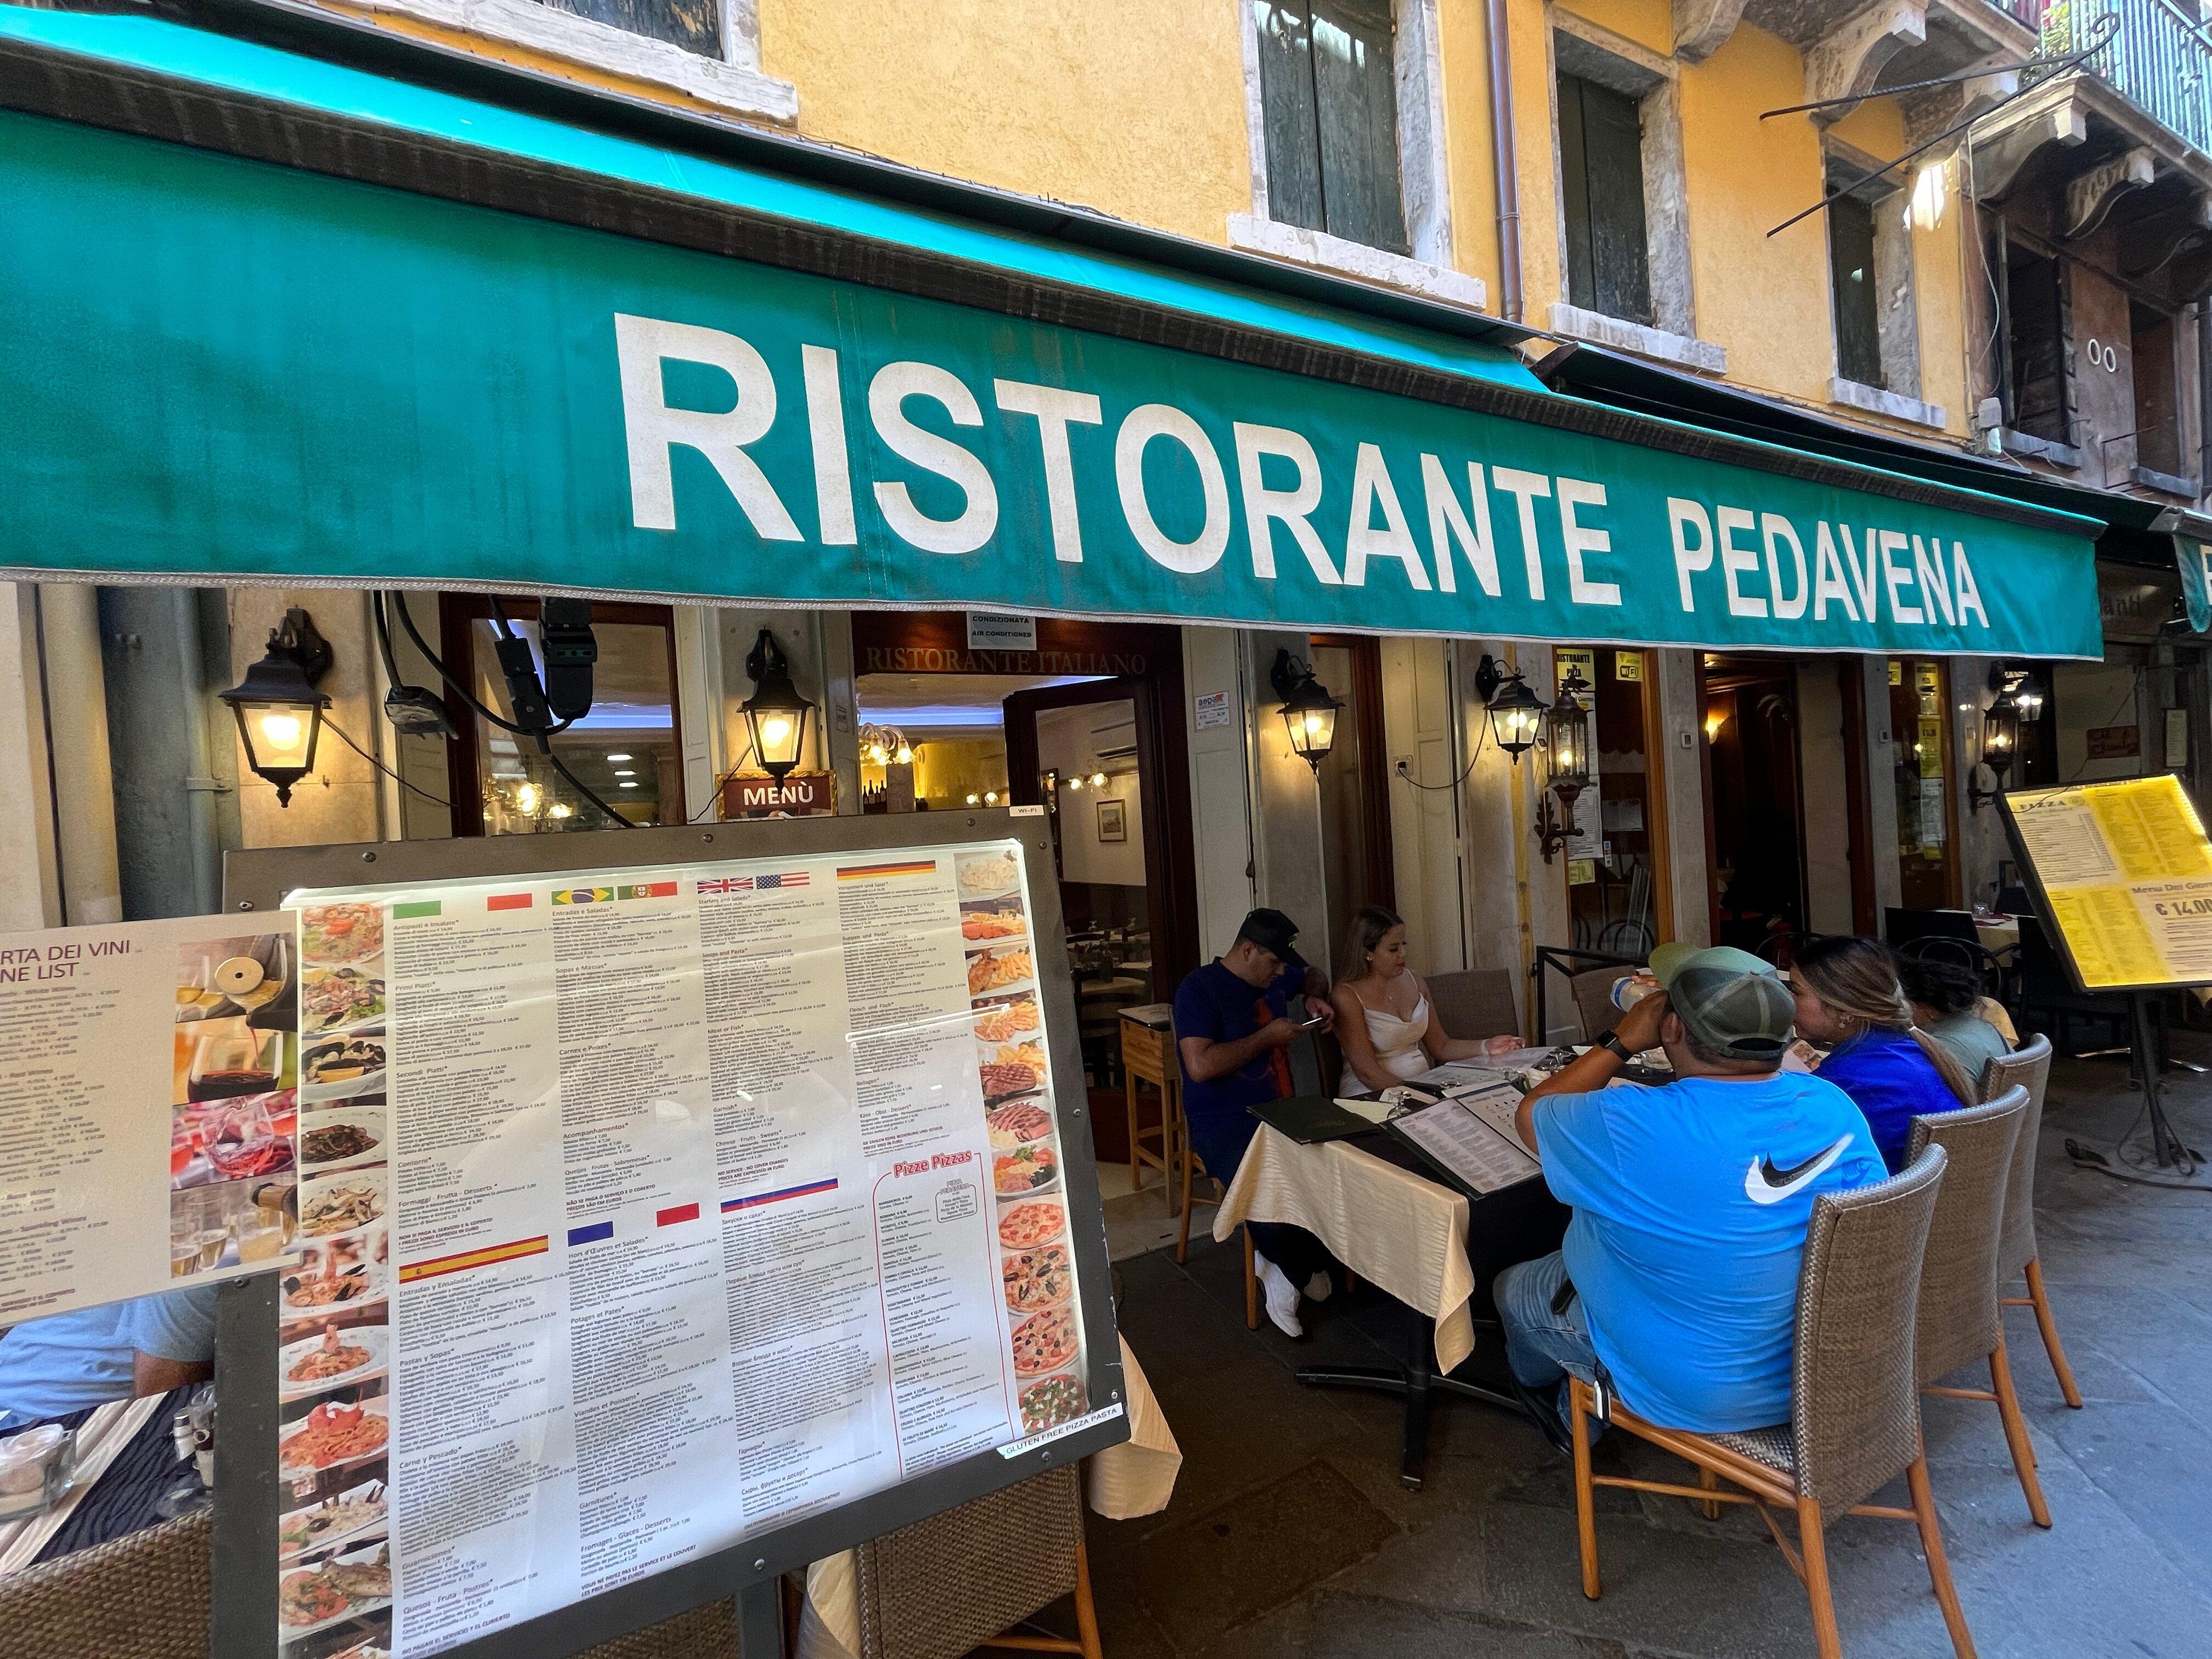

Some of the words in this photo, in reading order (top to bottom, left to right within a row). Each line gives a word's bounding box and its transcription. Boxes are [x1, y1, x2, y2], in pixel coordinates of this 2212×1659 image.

[614, 312, 1622, 607] RISTORANTE
[1666, 495, 1990, 629] PEDAVENA
[972, 616, 1030, 624] CONDIZIONATA
[866, 647, 1031, 673] RISTORANTE
[1039, 651, 1146, 675] ITALIANO
[743, 781, 813, 806] MENÙ
[2155, 903, 2168, 916] €
[393, 922, 423, 931] Antipasti
[48, 944, 81, 961] DEI
[88, 940, 131, 957] VINI
[38, 962, 80, 980] LIST
[396, 1069, 423, 1079] Secondi
[715, 1139, 736, 1147] Cheese
[893, 1159, 930, 1178] Pizze
[931, 1150, 973, 1170] Pizzas
[726, 1167, 743, 1175] SERVICE
[398, 1196, 431, 1207] Formaggi
[437, 1192, 458, 1201] Frutta
[464, 1185, 493, 1195] Desserts
[399, 1284, 430, 1297] Entradas
[570, 1314, 595, 1325] Potages
[399, 1357, 422, 1367] Pastas
[573, 1405, 600, 1418] Viandes
[1006, 1436, 1040, 1454] GLUTEN
[1042, 1427, 1064, 1441] FREE
[1066, 1418, 1090, 1431] PIZZA
[1091, 1408, 1118, 1422] PASTA
[580, 1537, 613, 1553] Fromages
[618, 1528, 640, 1540] Glaces
[644, 1516, 672, 1531] Desserts
